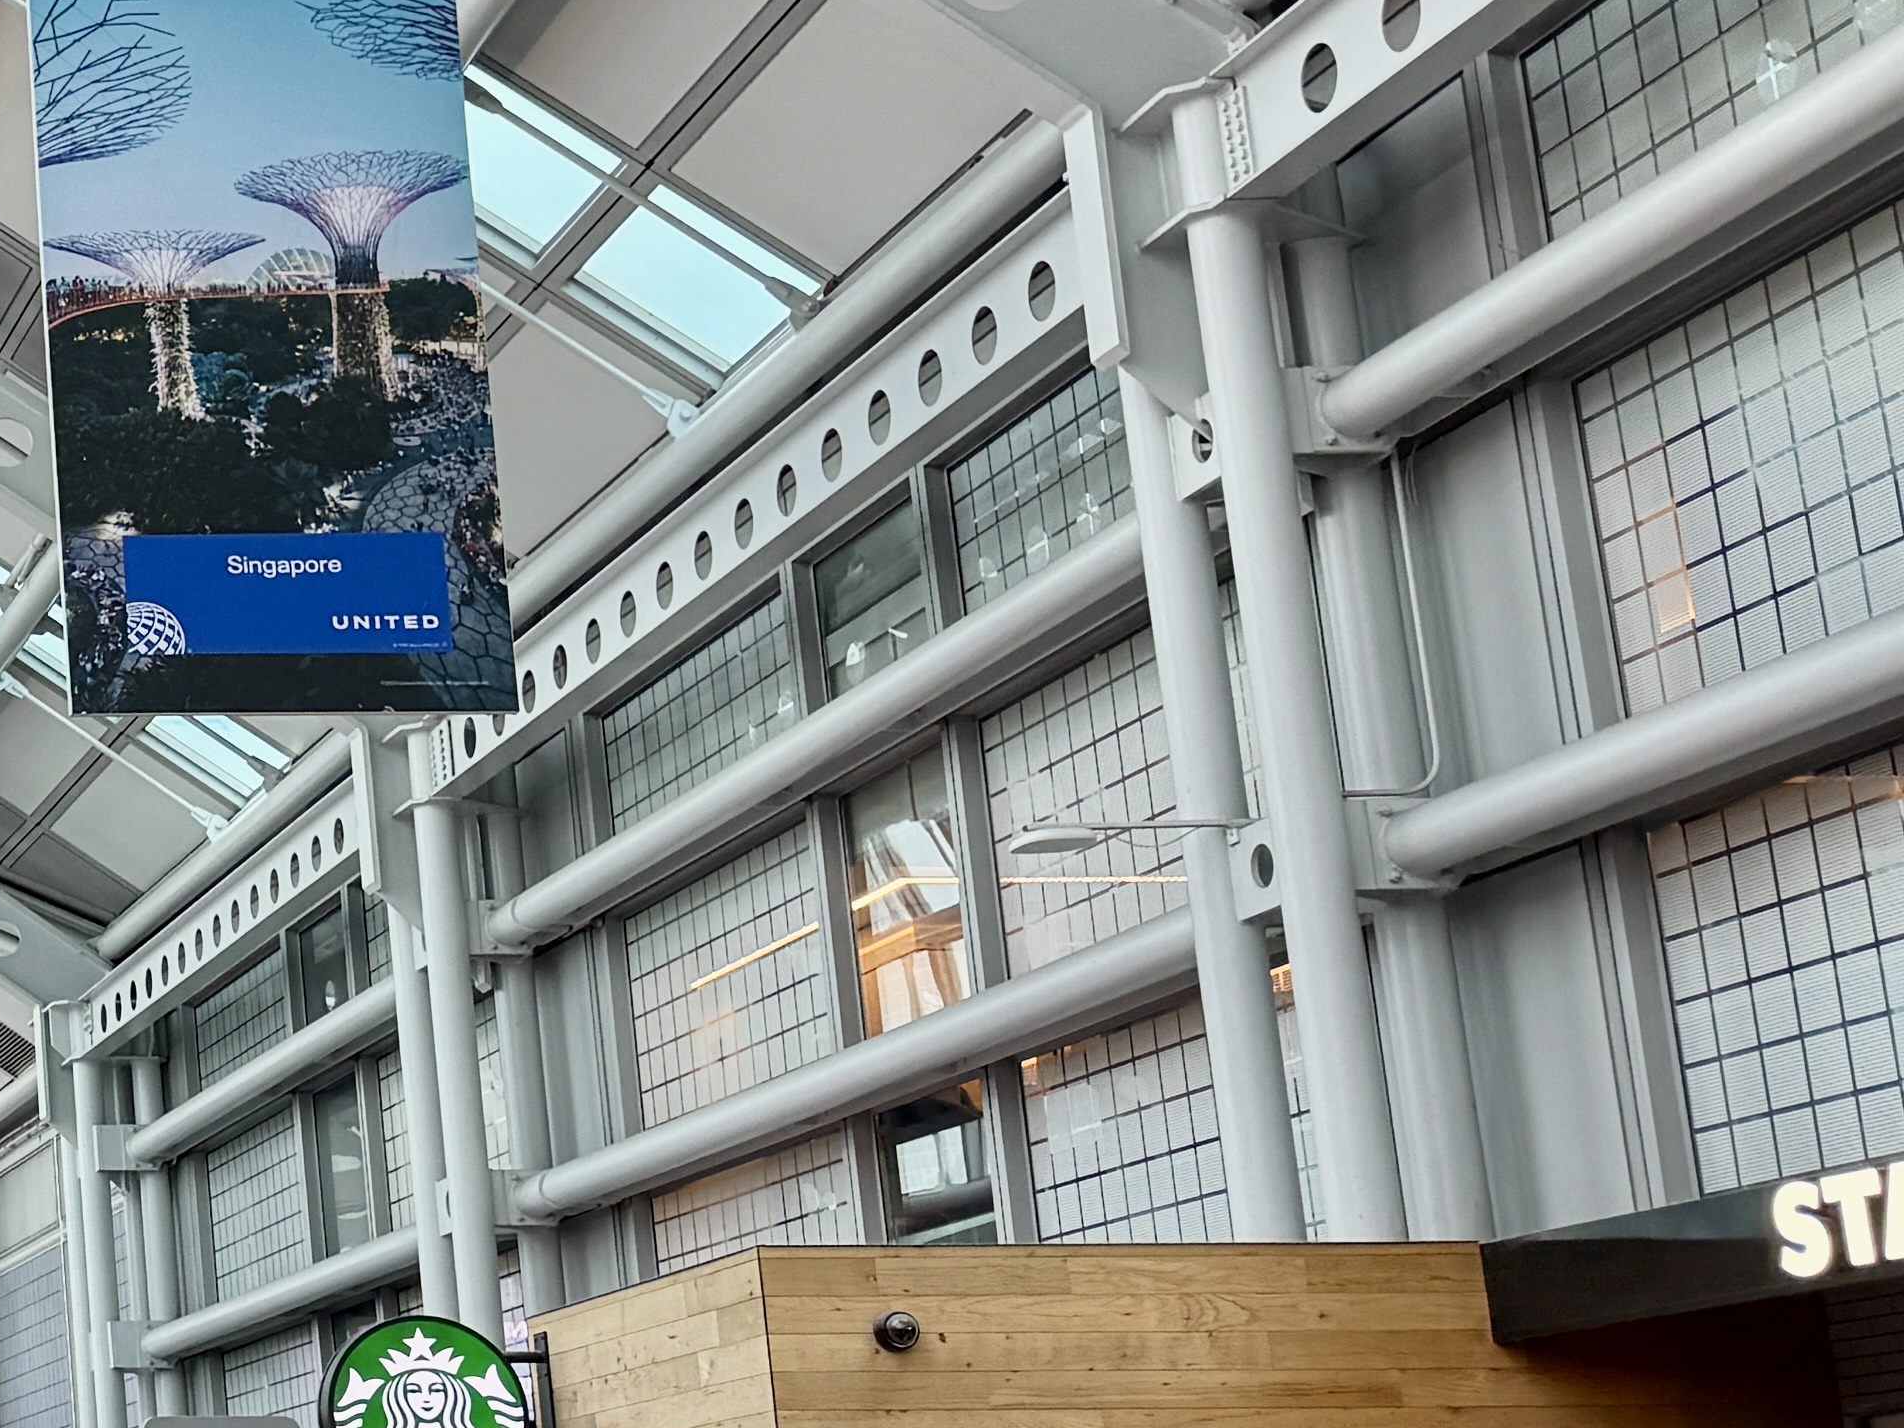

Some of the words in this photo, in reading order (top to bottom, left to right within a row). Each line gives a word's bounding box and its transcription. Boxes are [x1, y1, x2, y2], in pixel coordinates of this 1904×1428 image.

[227, 555, 343, 578] Singapore
[333, 614, 439, 630] UNITED
[1773, 1164, 1904, 1277] ST
